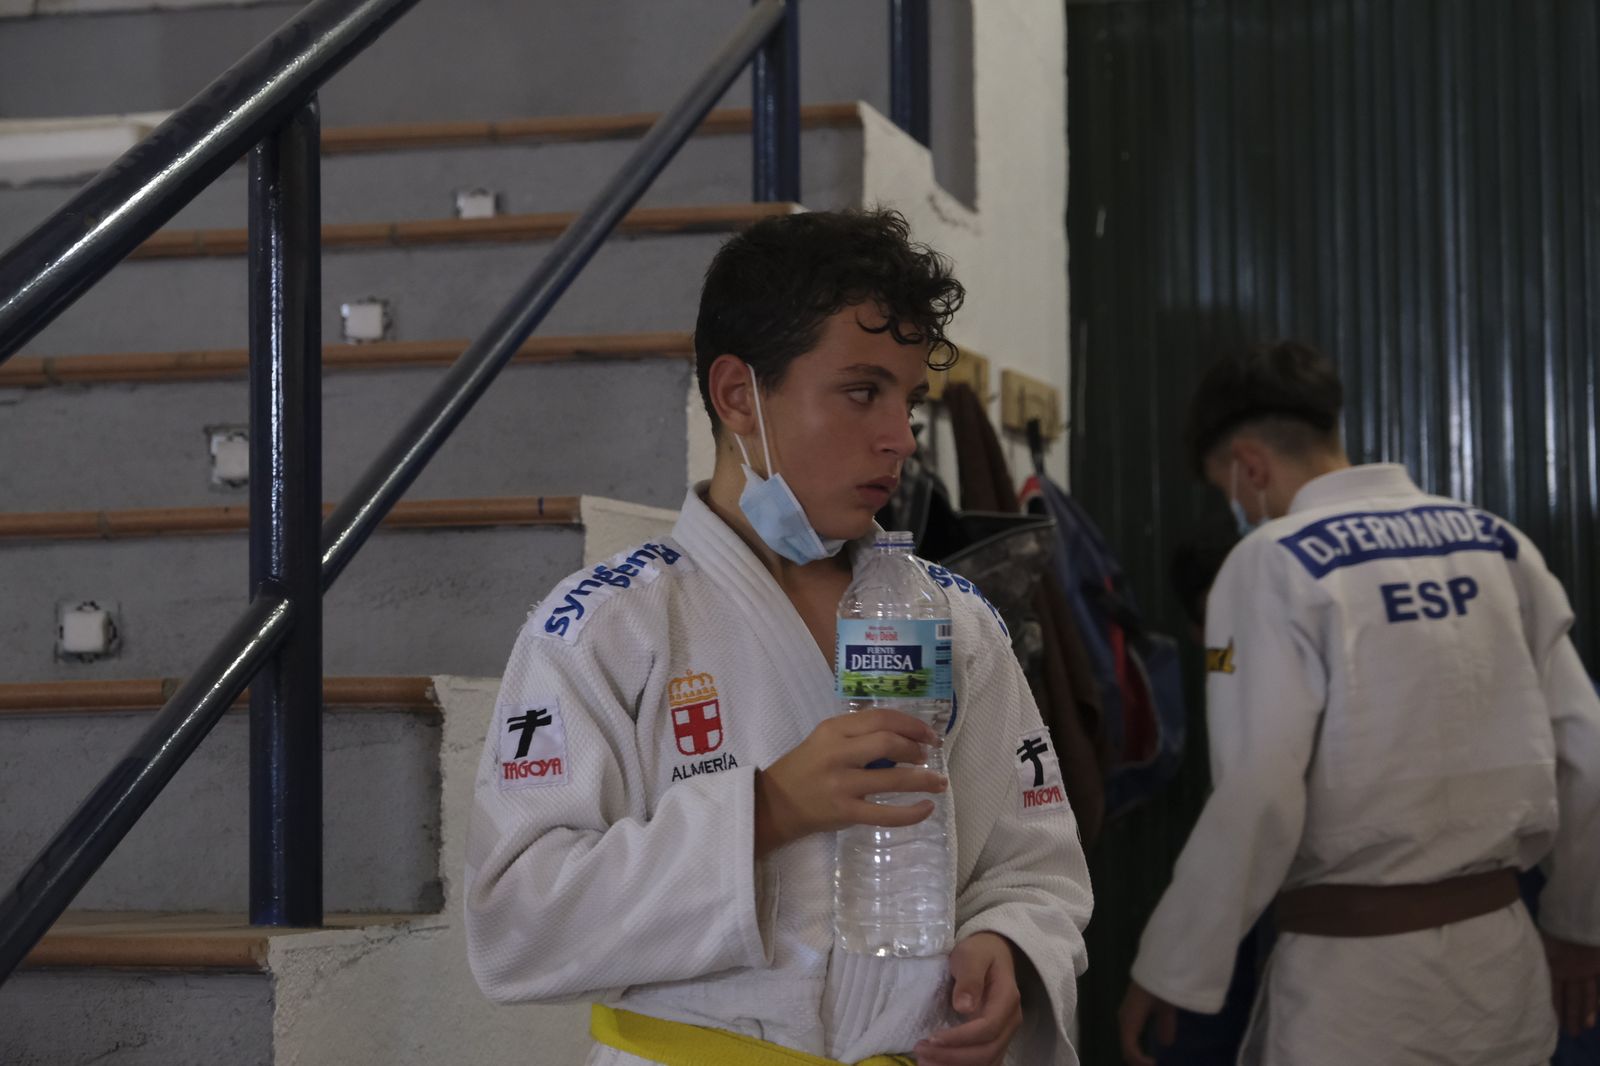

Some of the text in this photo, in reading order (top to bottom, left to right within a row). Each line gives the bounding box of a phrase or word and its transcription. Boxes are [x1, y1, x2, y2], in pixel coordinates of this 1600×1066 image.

[1380, 576, 1479, 624] ESP
[851, 654, 914, 671] DEHESA
[502, 757, 563, 780] TAGOYA
[671, 753, 739, 782] ALMERÍA
[1023, 785, 1064, 809] TAGOYA
